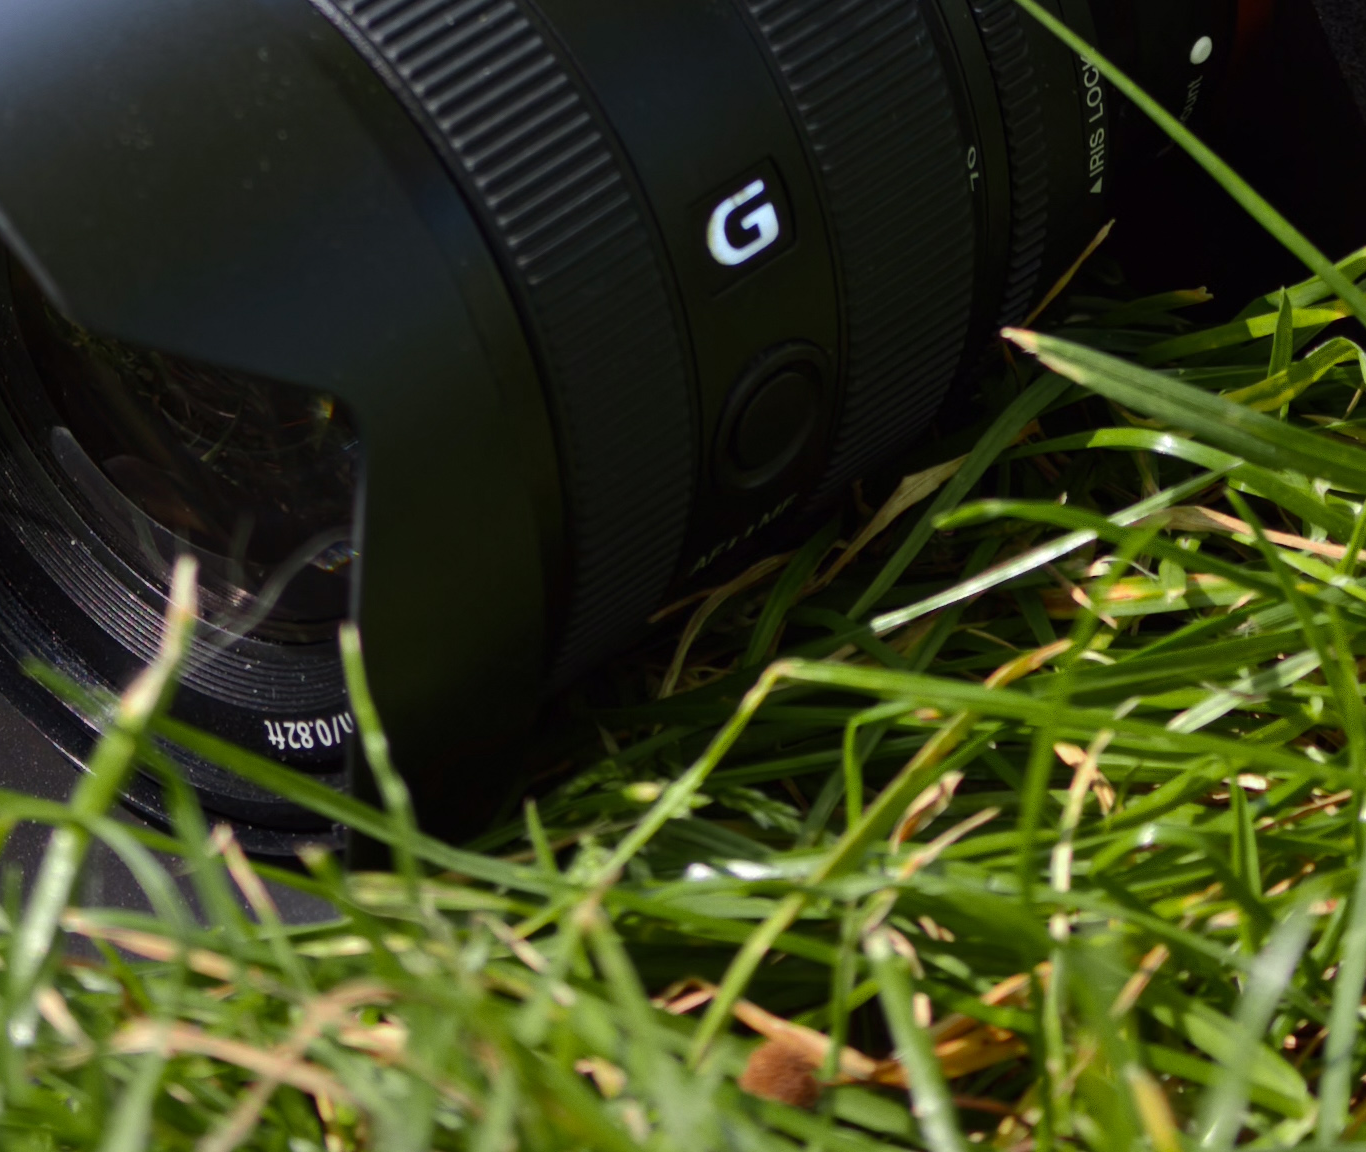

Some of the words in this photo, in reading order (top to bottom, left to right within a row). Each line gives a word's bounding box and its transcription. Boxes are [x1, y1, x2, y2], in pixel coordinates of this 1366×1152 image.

[967, 146, 980, 192] 70
[1088, 127, 1105, 178] IRIS
[706, 178, 779, 266] G
